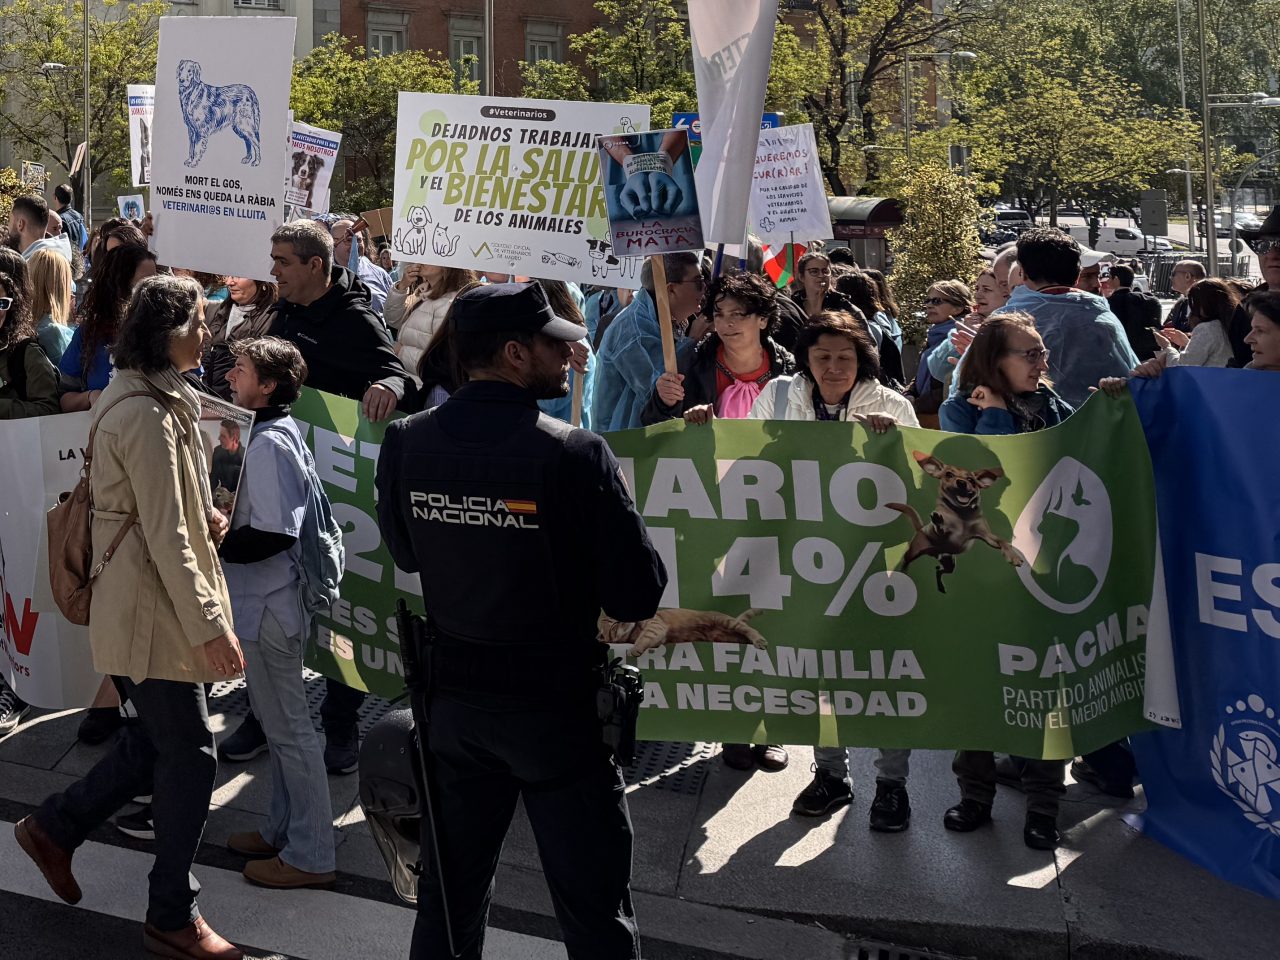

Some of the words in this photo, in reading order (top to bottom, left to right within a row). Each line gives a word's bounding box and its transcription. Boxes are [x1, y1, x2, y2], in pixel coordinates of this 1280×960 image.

[489, 107, 548, 119] #Veterinarios
[431, 122, 513, 144] DEJADNOS
[405, 137, 469, 174] POR
[475, 145, 511, 177] LA
[519, 147, 604, 187] SALU
[156, 185, 183, 198] NOMÉS
[185, 189, 201, 200] ENS
[203, 190, 232, 203] QUEDA
[234, 194, 246, 205] LA
[185, 175, 209, 187] MORT
[210, 178, 221, 188] EL
[222, 179, 243, 191] GOS,
[420, 175, 428, 189] Y
[430, 176, 443, 191] EL
[443, 172, 607, 219] BIENESTAR
[162, 200, 221, 216] VETERINARI@S
[223, 206, 235, 217] EN
[236, 208, 267, 221] LLUITA
[454, 208, 471, 223] DE
[476, 210, 504, 227] LOS
[508, 213, 584, 235] ANIMALES
[615, 226, 697, 239] BUROCRACIA
[59, 449, 76, 461] LA
[410, 491, 509, 512] POLICIA
[412, 506, 540, 529] NACIONAL
[1195, 551, 1280, 639] ES
[998, 603, 1150, 679] PACMA
[713, 642, 926, 680] FAMILIA
[676, 682, 928, 717] NECESIDAD
[1003, 675, 1086, 711] PARTIDO
[1004, 709, 1043, 729] CON
[1047, 711, 1070, 729] EL
[1071, 695, 1109, 726] MEDIO
